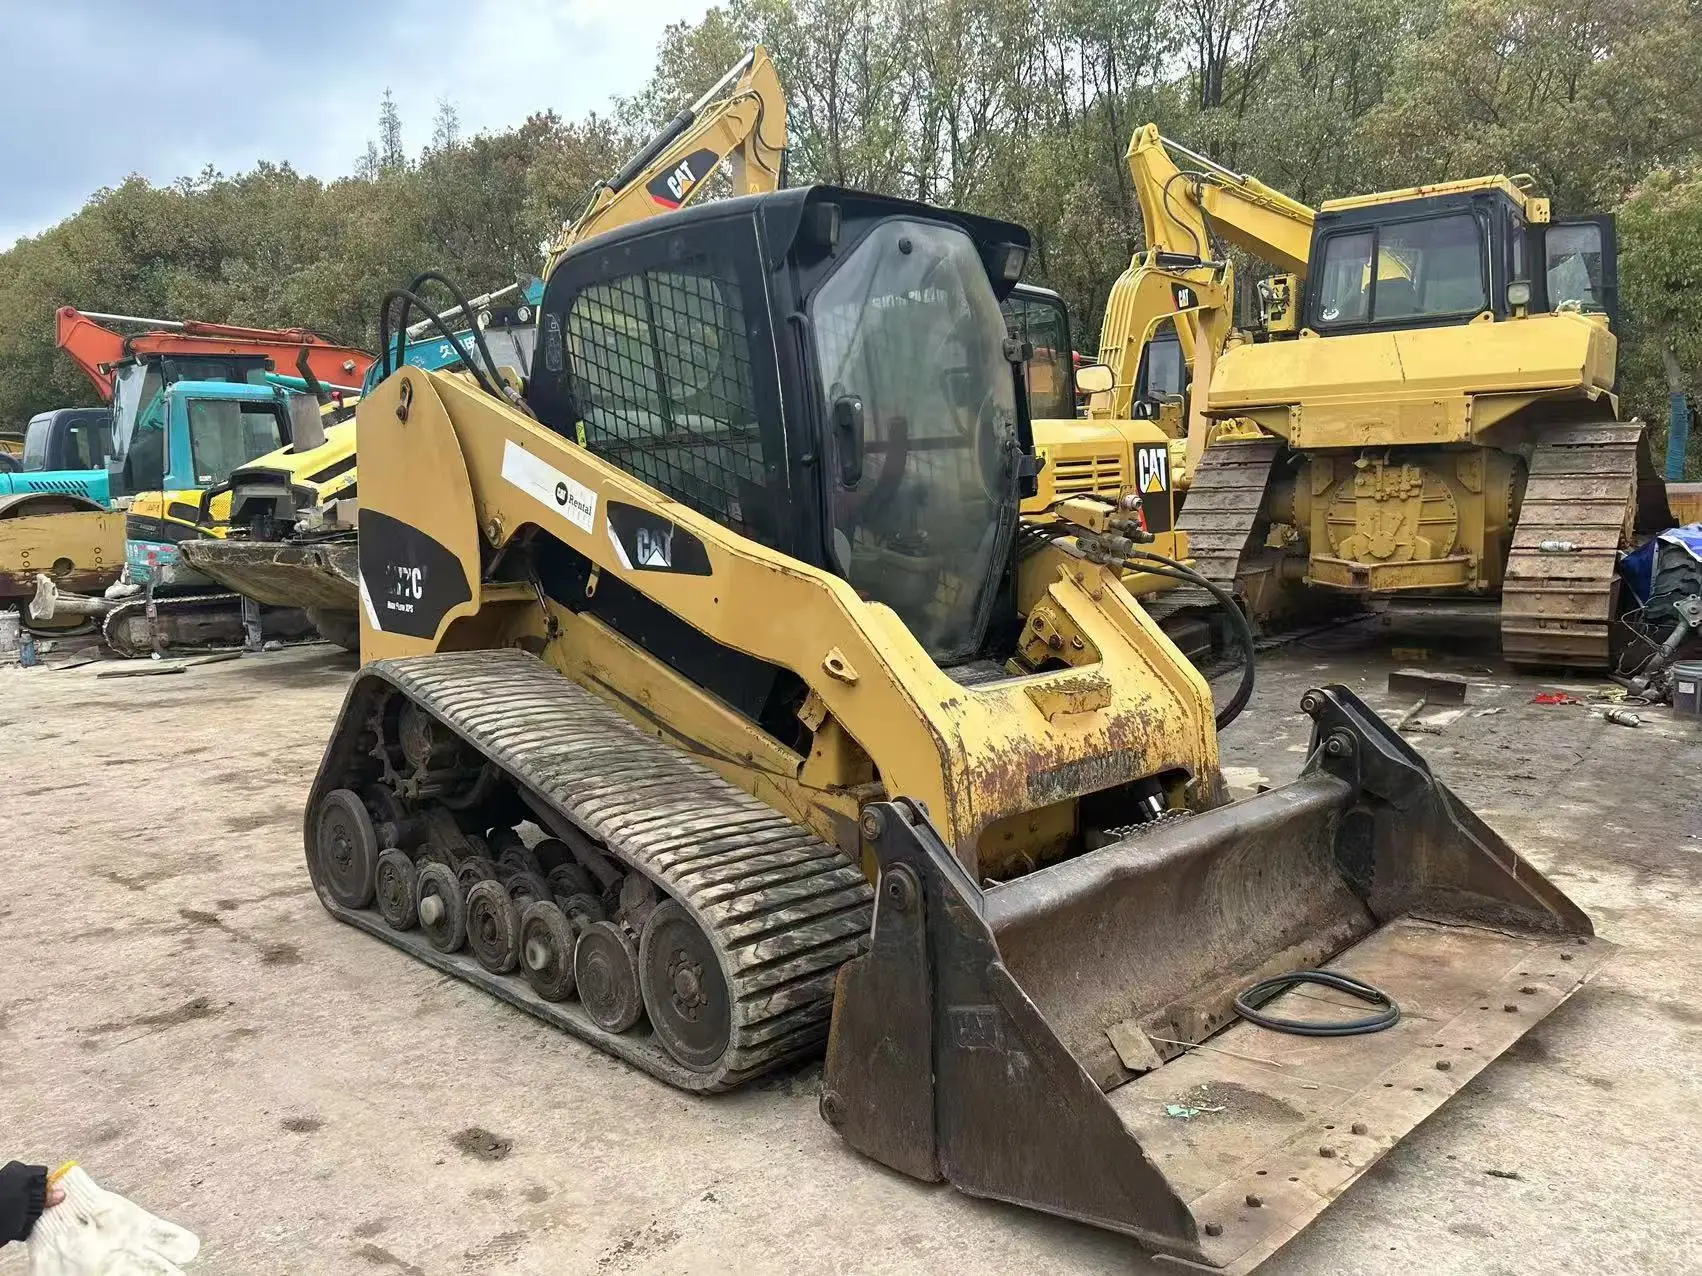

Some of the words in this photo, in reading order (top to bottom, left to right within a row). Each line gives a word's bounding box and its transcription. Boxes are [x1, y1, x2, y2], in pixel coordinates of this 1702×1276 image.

[667, 160, 696, 199] CAT
[1178, 289, 1189, 307] CAT
[1138, 448, 1167, 494] CAT
[568, 494, 593, 517] Rental
[636, 527, 673, 568] CAT
